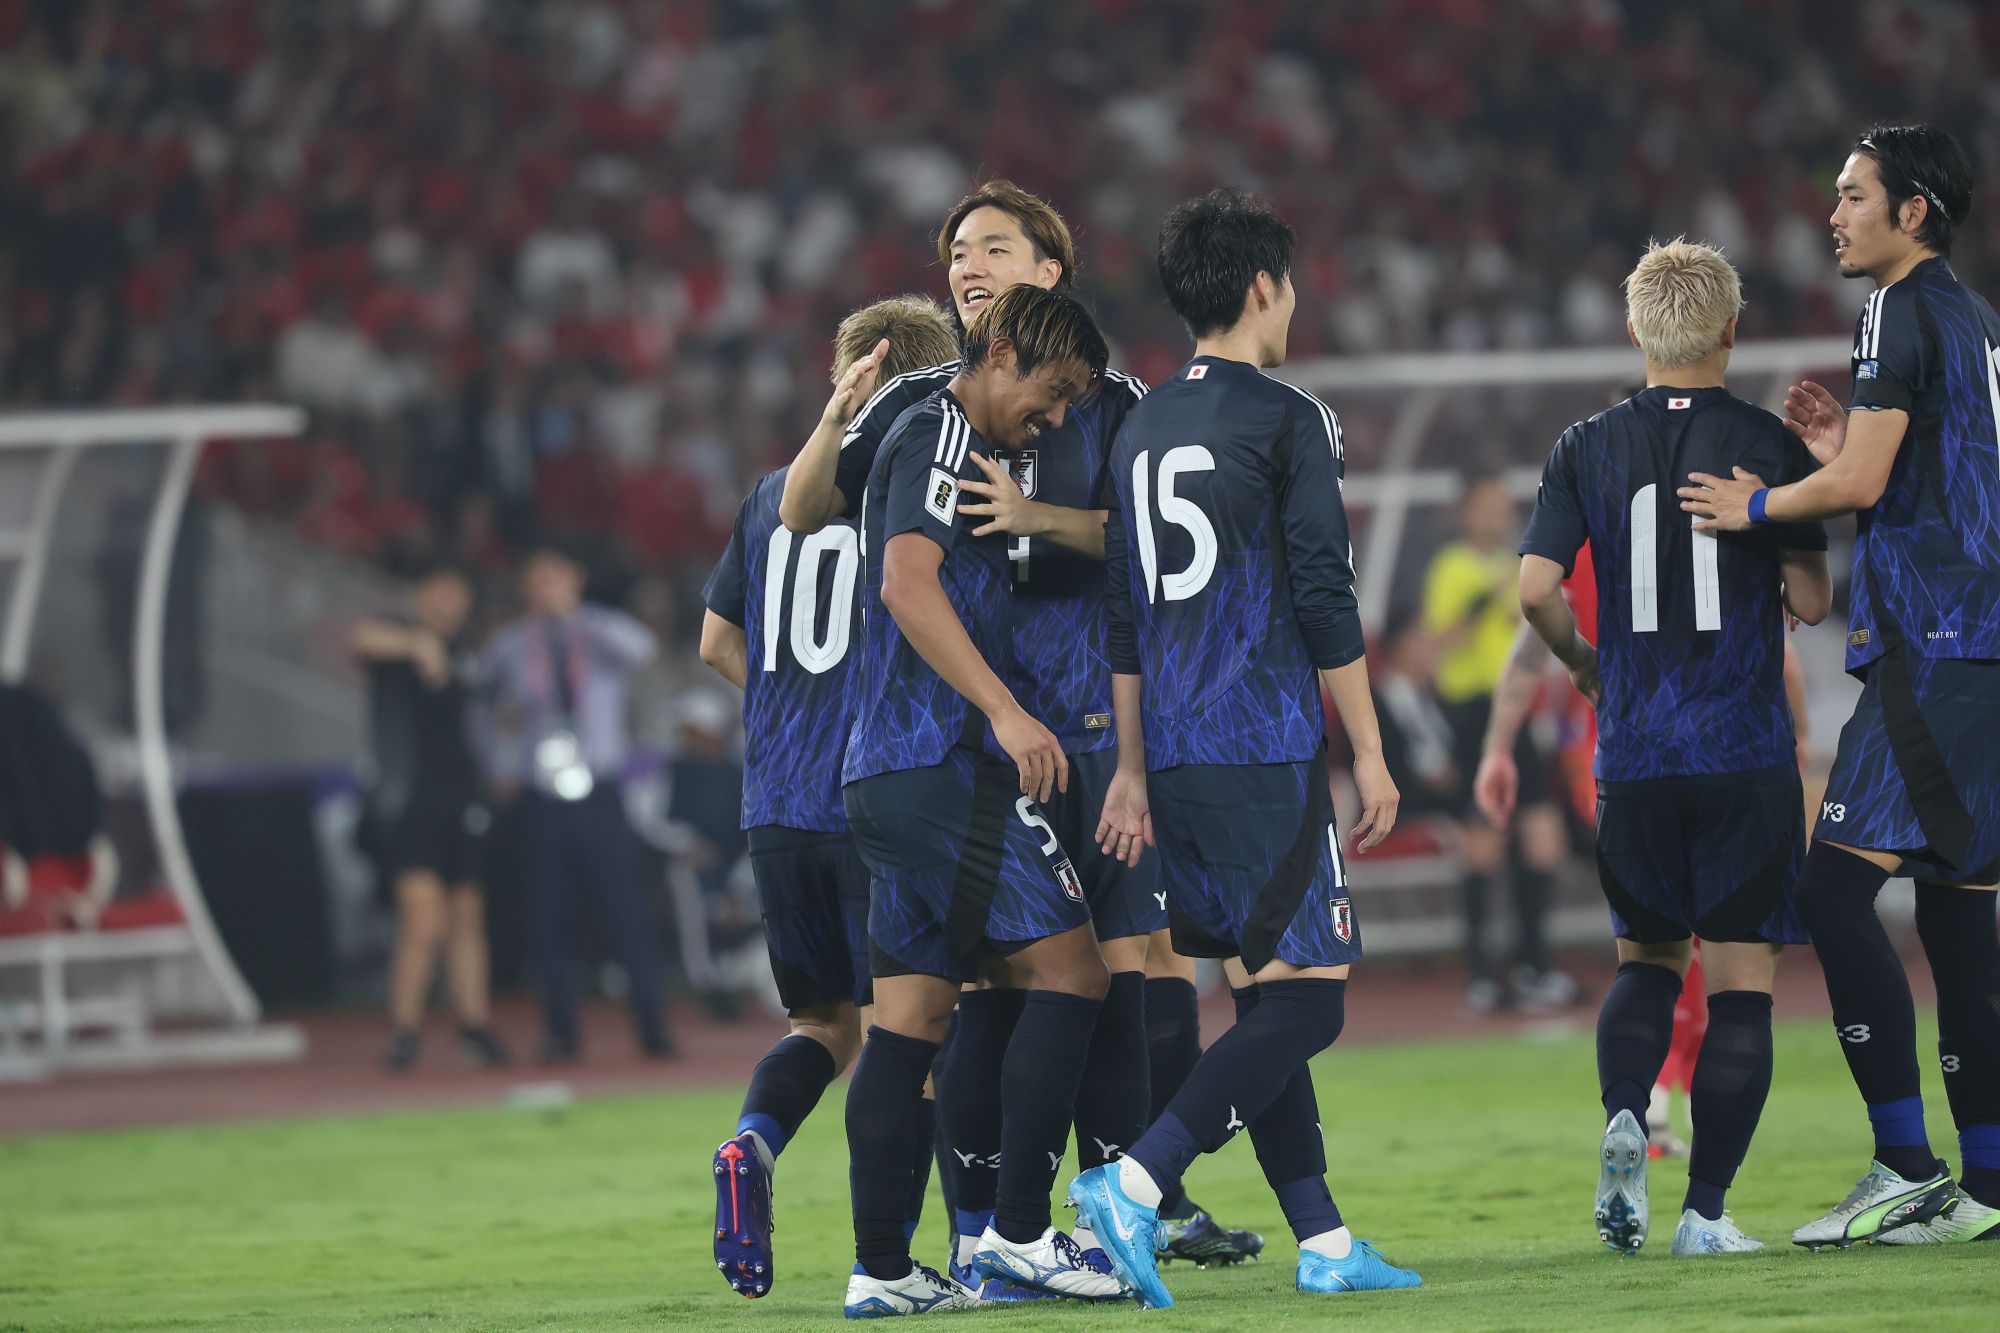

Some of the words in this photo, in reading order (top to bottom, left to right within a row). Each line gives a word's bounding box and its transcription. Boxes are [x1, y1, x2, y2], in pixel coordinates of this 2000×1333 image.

[763, 523, 859, 674] 10
[1133, 445, 1218, 604] 15
[1631, 483, 1722, 632] 11
[1015, 795, 1058, 857] 5
[1822, 801, 1846, 822] Y-3
